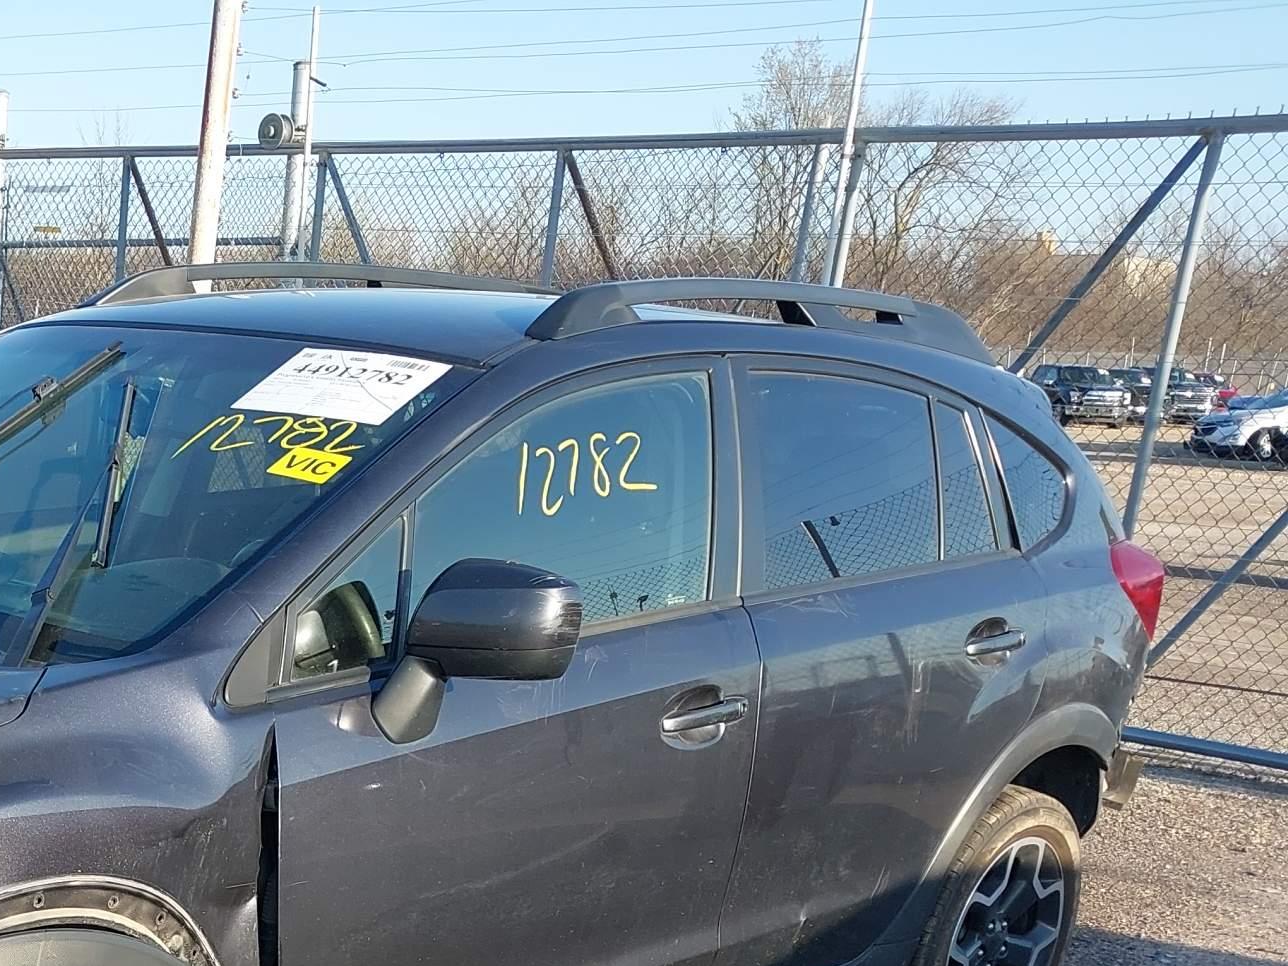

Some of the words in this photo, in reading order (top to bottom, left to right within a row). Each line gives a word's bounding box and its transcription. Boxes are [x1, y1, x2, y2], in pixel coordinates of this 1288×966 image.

[292, 361, 414, 387] 44912782
[170, 414, 366, 460] 12782
[285, 454, 337, 476] VIC
[517, 431, 658, 517] 12782
